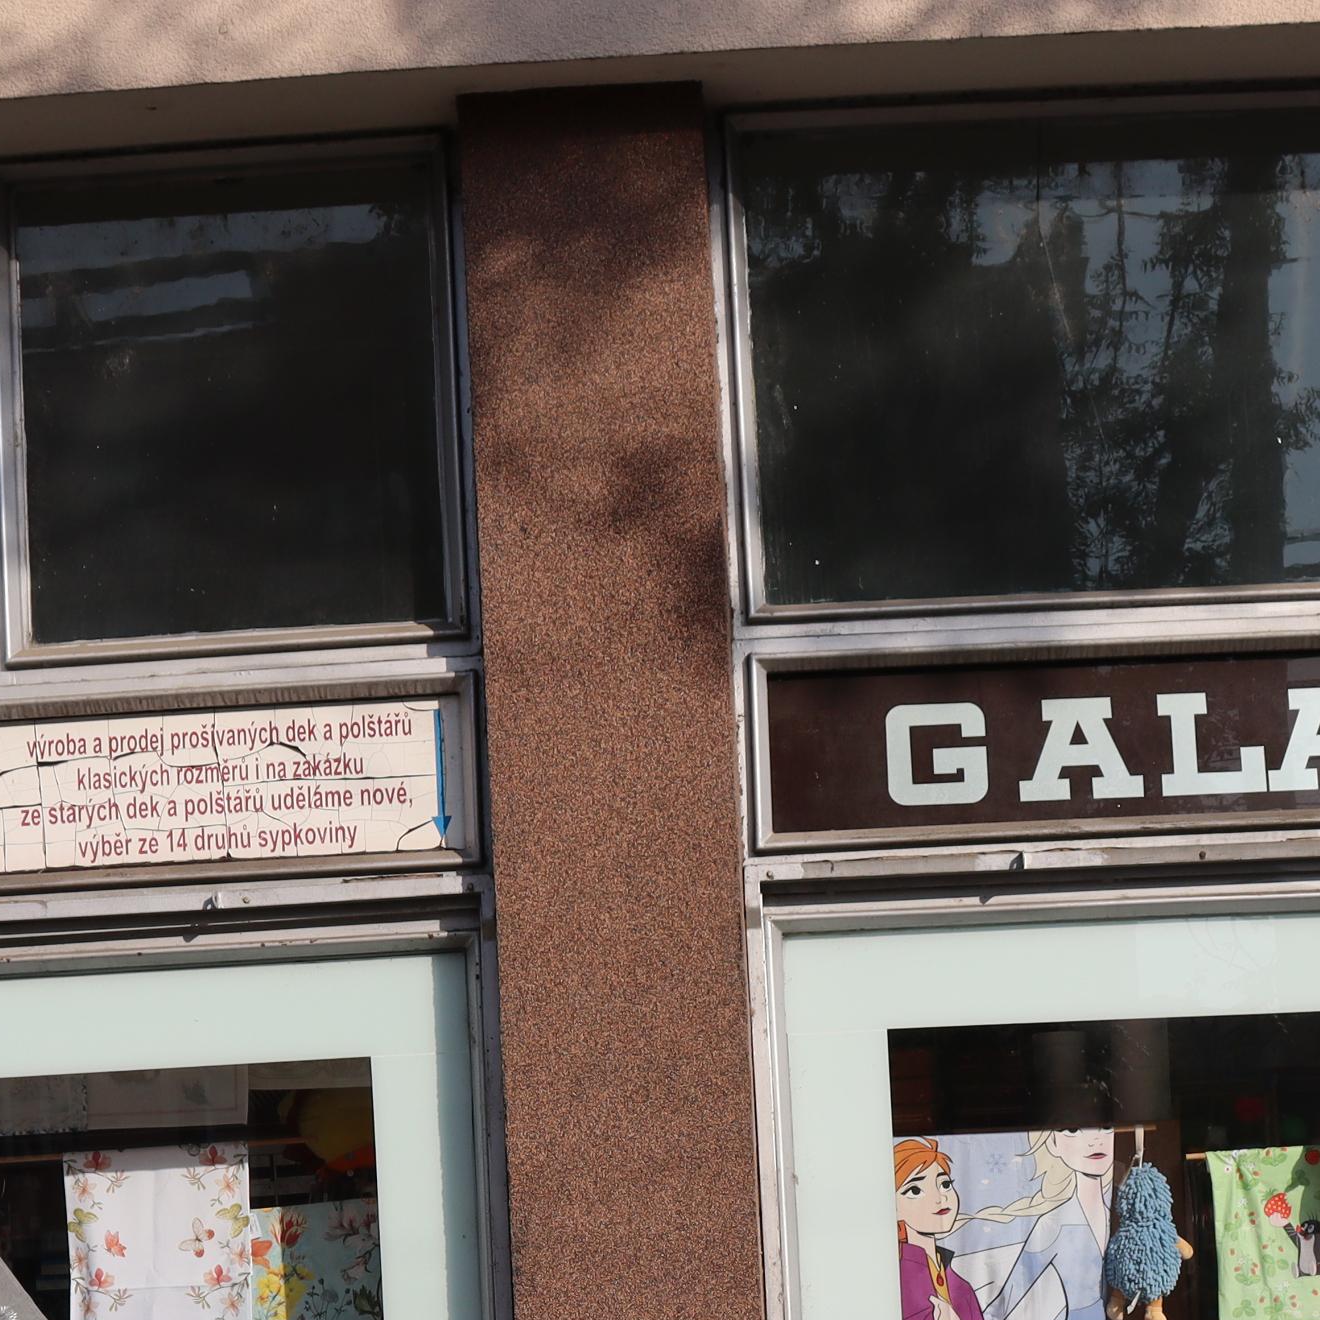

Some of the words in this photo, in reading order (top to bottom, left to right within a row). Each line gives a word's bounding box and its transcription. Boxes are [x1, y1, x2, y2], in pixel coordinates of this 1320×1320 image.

[27, 733, 87, 760] výroba
[93, 736, 102, 754] a
[109, 727, 165, 758] prodej
[171, 721, 280, 756] prošívaných
[285, 718, 318, 743] dek
[323, 723, 333, 741] a
[339, 711, 412, 748] polštářů
[77, 764, 171, 794] klasických
[176, 758, 249, 786] rozměrů
[255, 757, 260, 780] i
[266, 761, 287, 779] na
[292, 751, 364, 778] zakázku
[21, 809, 41, 826] ze
[48, 797, 120, 829] starých
[126, 795, 162, 819] dek
[167, 799, 178, 817] a
[184, 787, 264, 822] polštářů
[271, 783, 354, 811] uděláme
[360, 781, 413, 808] nové,
[78, 832, 131, 864] výběr
[138, 837, 159, 855] ze
[167, 829, 187, 852] 14
[194, 823, 251, 851] druhů
[258, 821, 358, 852] sypkoviny
